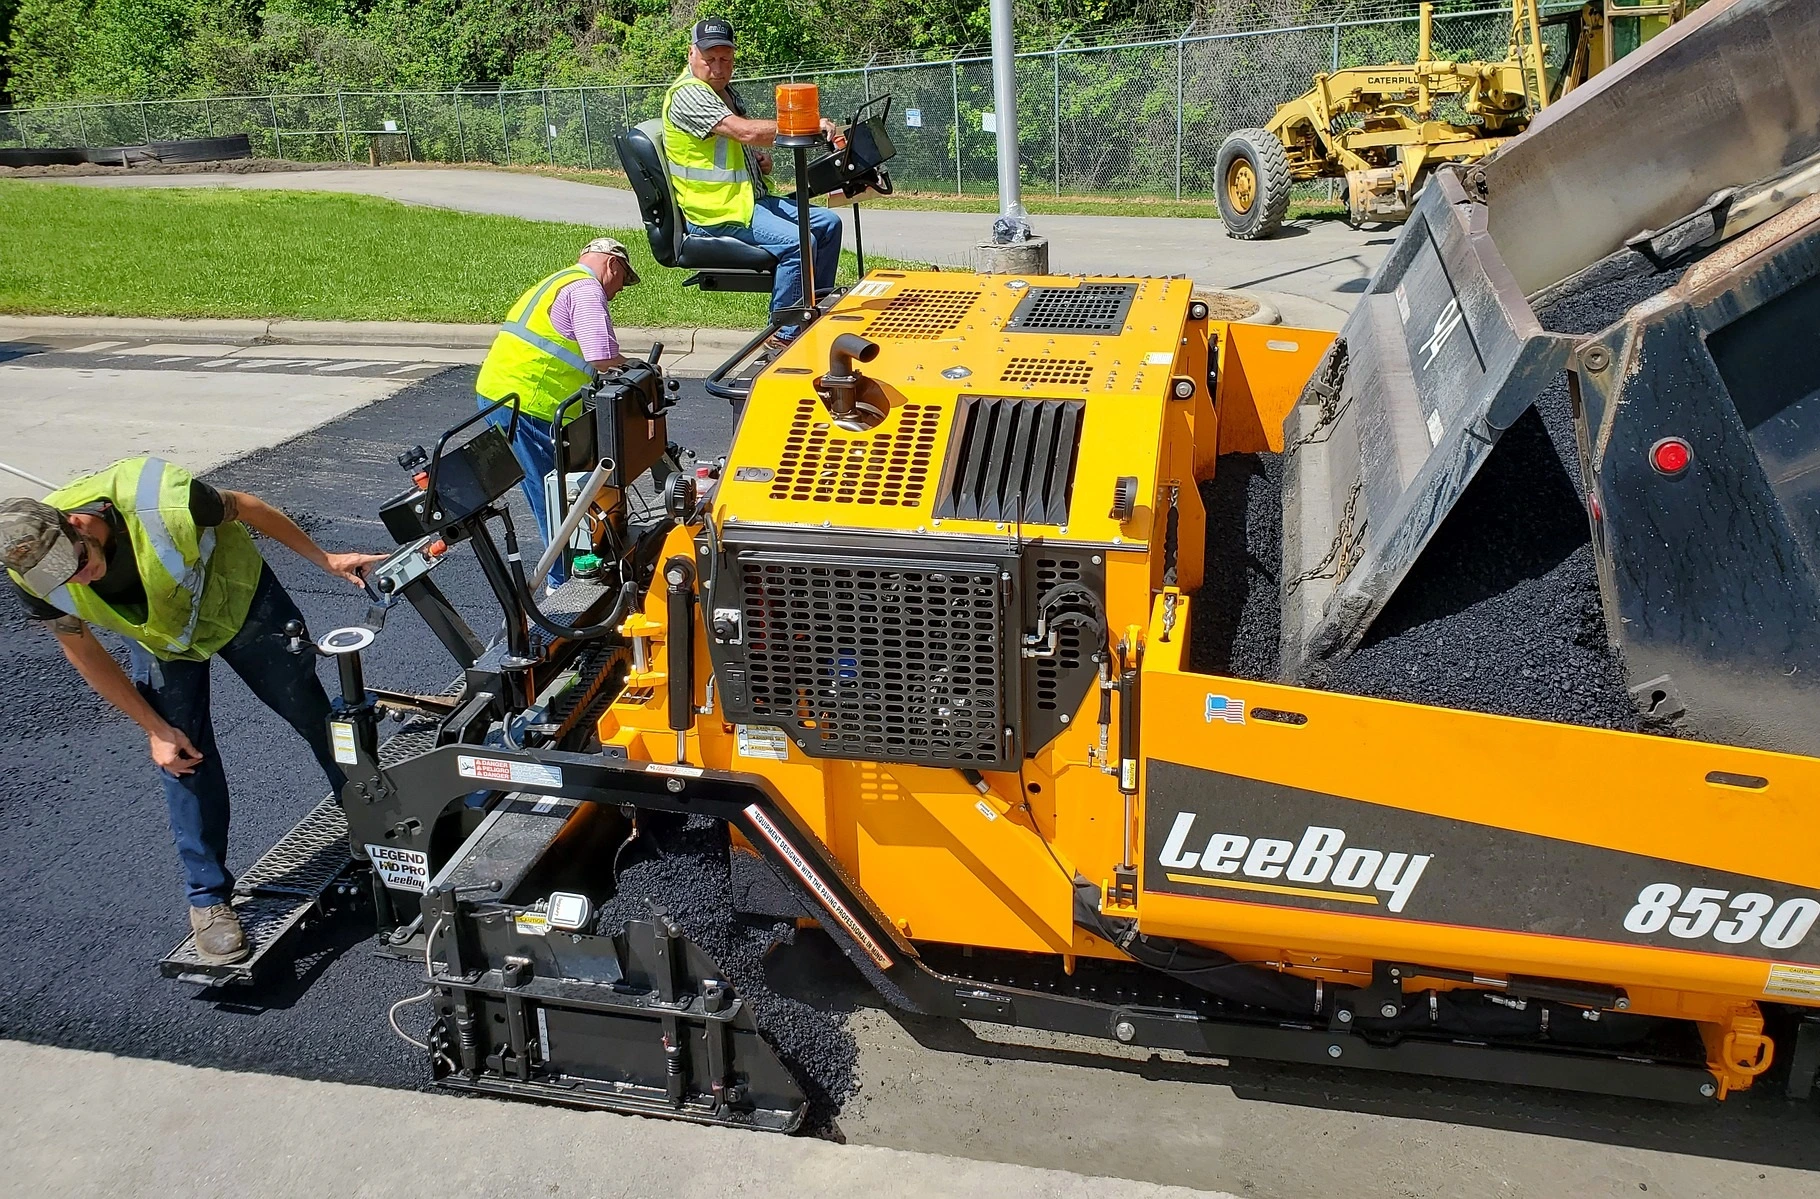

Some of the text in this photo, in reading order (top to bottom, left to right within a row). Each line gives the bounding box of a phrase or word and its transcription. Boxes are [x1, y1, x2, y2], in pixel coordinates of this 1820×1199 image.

[1368, 76, 1433, 84] CATERPILLR
[482, 760, 508, 768] DANGER
[483, 771, 510, 779] DANGER
[372, 847, 425, 865] LEGEND
[1158, 811, 1432, 913] LeeBoy
[401, 864, 426, 876] PRO
[388, 873, 426, 890] LeeBoy
[779, 840, 803, 869] DESIGNED
[800, 863, 814, 881] WITH
[811, 878, 822, 890] THE
[820, 888, 838, 909] PAVING
[836, 906, 868, 944] PROFESSIONAL
[866, 940, 873, 950] IN
[1623, 883, 1820, 949] 8530
